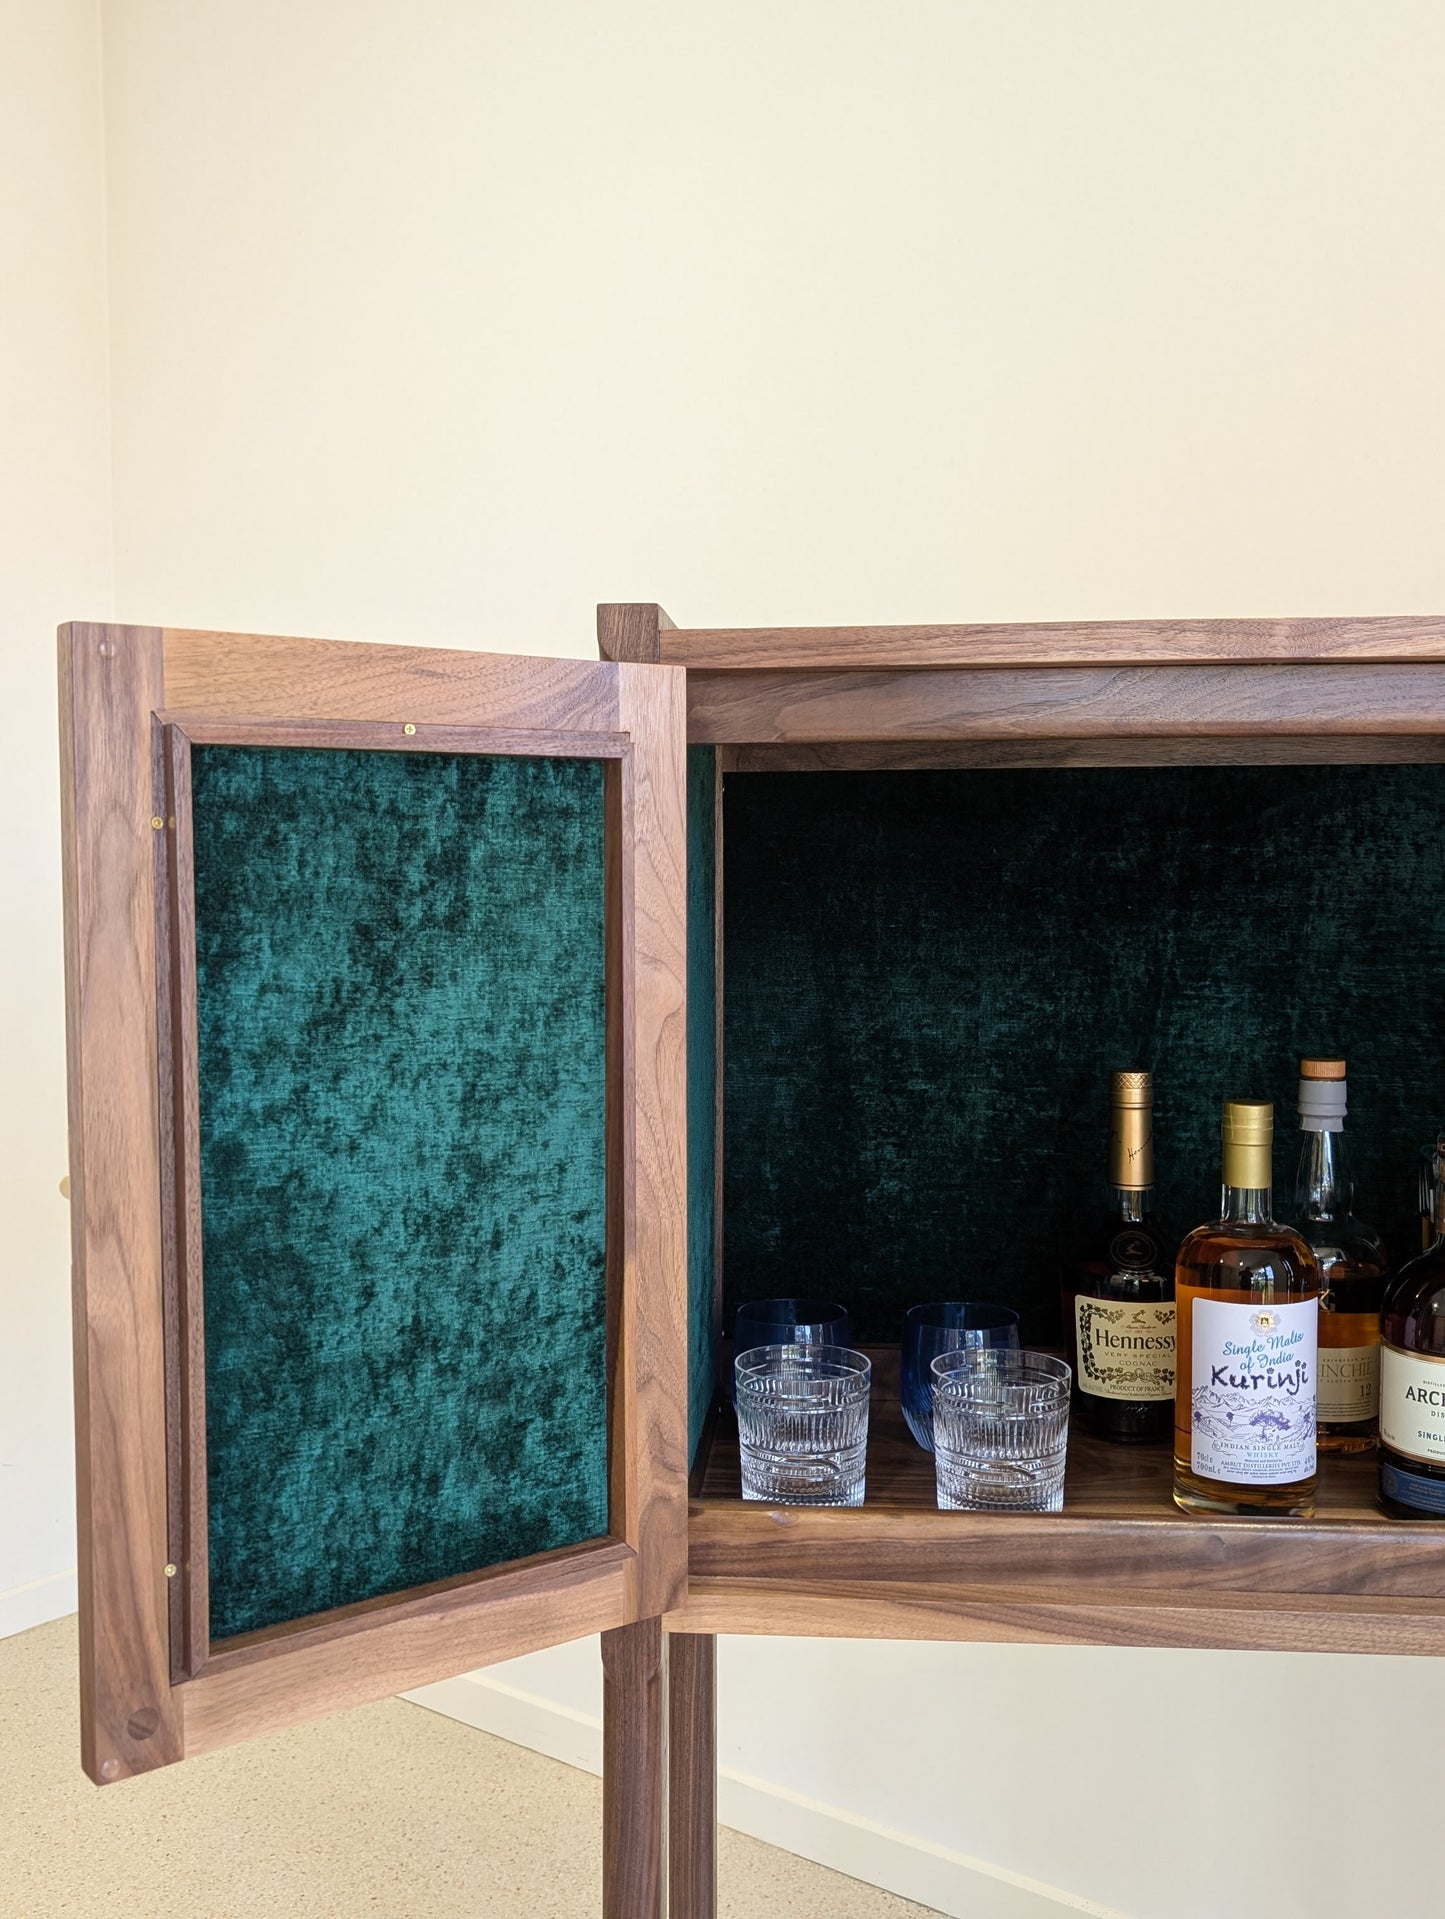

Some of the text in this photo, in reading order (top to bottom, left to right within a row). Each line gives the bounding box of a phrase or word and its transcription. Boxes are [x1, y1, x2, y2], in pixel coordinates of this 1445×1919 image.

[1222, 1331, 1304, 1358] Single Malts
[1239, 1352, 1294, 1374] of India
[1210, 1359, 1309, 1396] Kurinji
[1359, 1383, 1372, 1397] 12
[1417, 1430, 1445, 1442] SINGL
[1220, 1442, 1250, 1450] INDIAN
[1283, 1442, 1300, 1450] MALT
